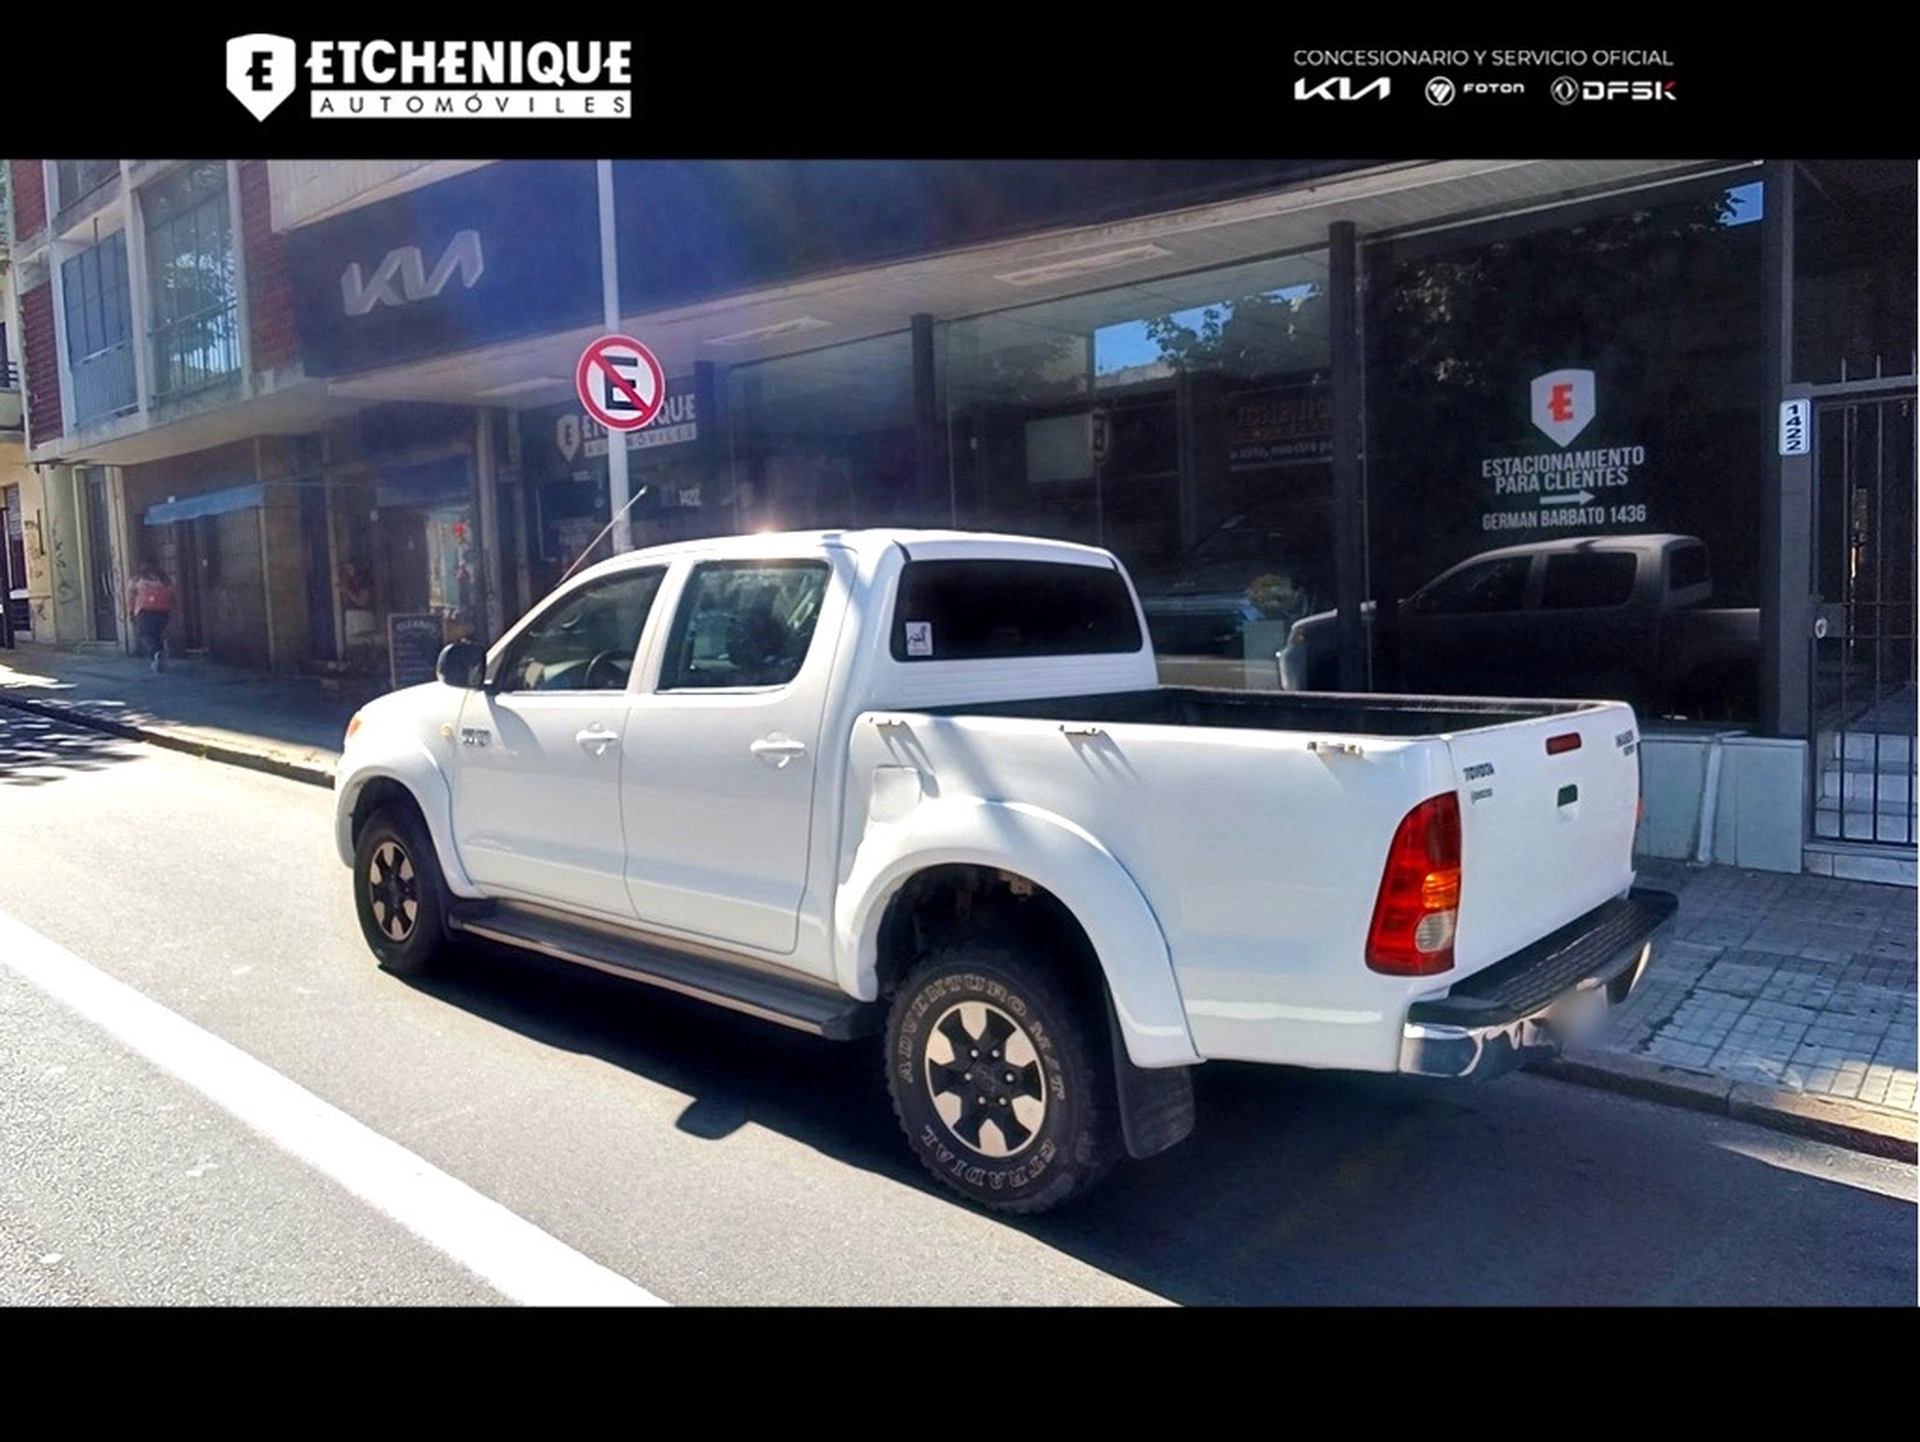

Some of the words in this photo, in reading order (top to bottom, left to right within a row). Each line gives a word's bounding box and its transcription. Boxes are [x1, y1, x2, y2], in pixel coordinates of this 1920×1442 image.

[340, 229, 484, 316] KIA
[603, 355, 643, 411] E
[1786, 404, 1802, 452] 1422
[1482, 446, 1645, 478] ESTACIONAMIENTO
[1495, 473, 1541, 494] PARA
[1544, 466, 1629, 491] CLIENTES
[1482, 512, 1538, 530] GERMAN
[1541, 507, 1605, 527] BARBATO
[1610, 504, 1647, 523] 1436
[920, 1124, 1029, 1190] RADIAL
